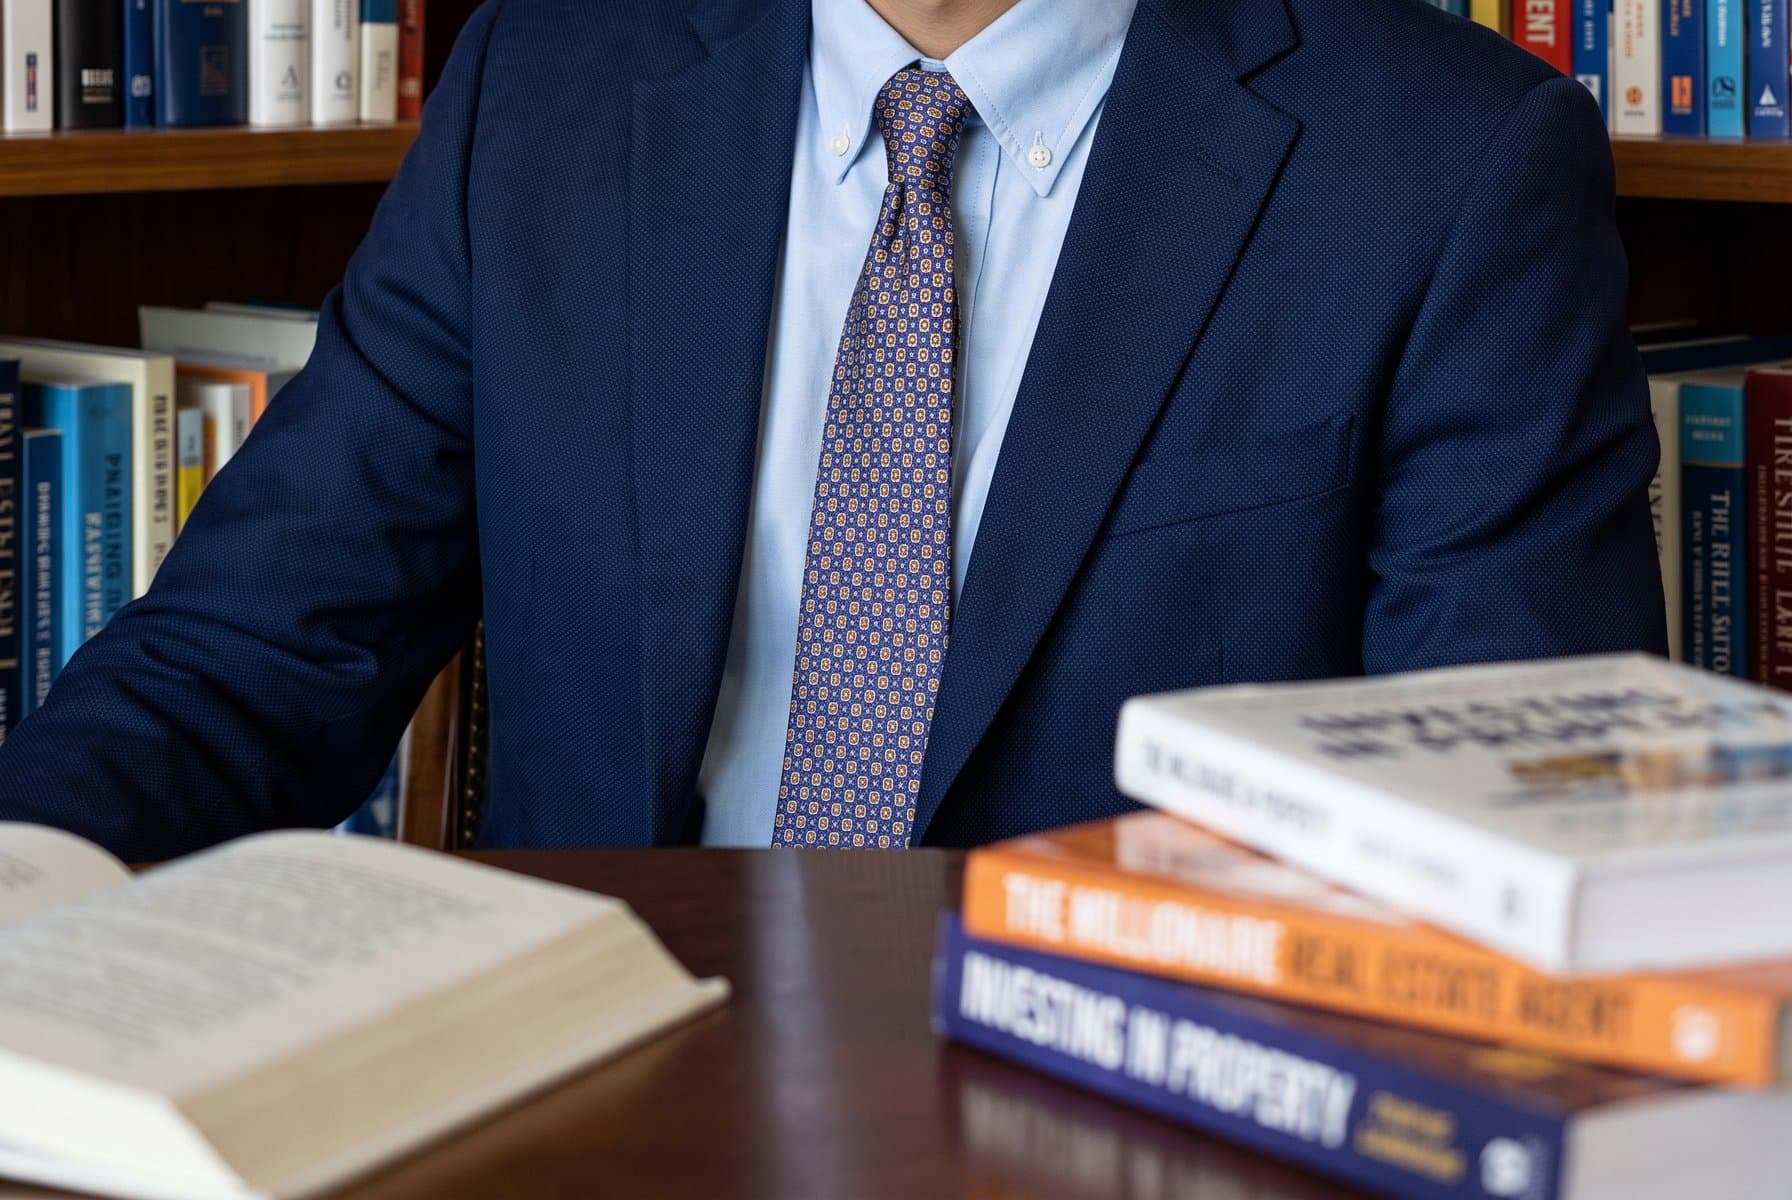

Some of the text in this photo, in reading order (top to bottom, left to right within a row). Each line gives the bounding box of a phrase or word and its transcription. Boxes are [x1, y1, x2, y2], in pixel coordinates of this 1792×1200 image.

[1003, 872, 1064, 941] THE
[960, 950, 1126, 1072] INVESTING
[1124, 1004, 1170, 1087] IN
[1167, 1016, 1357, 1150] PROPERTY
